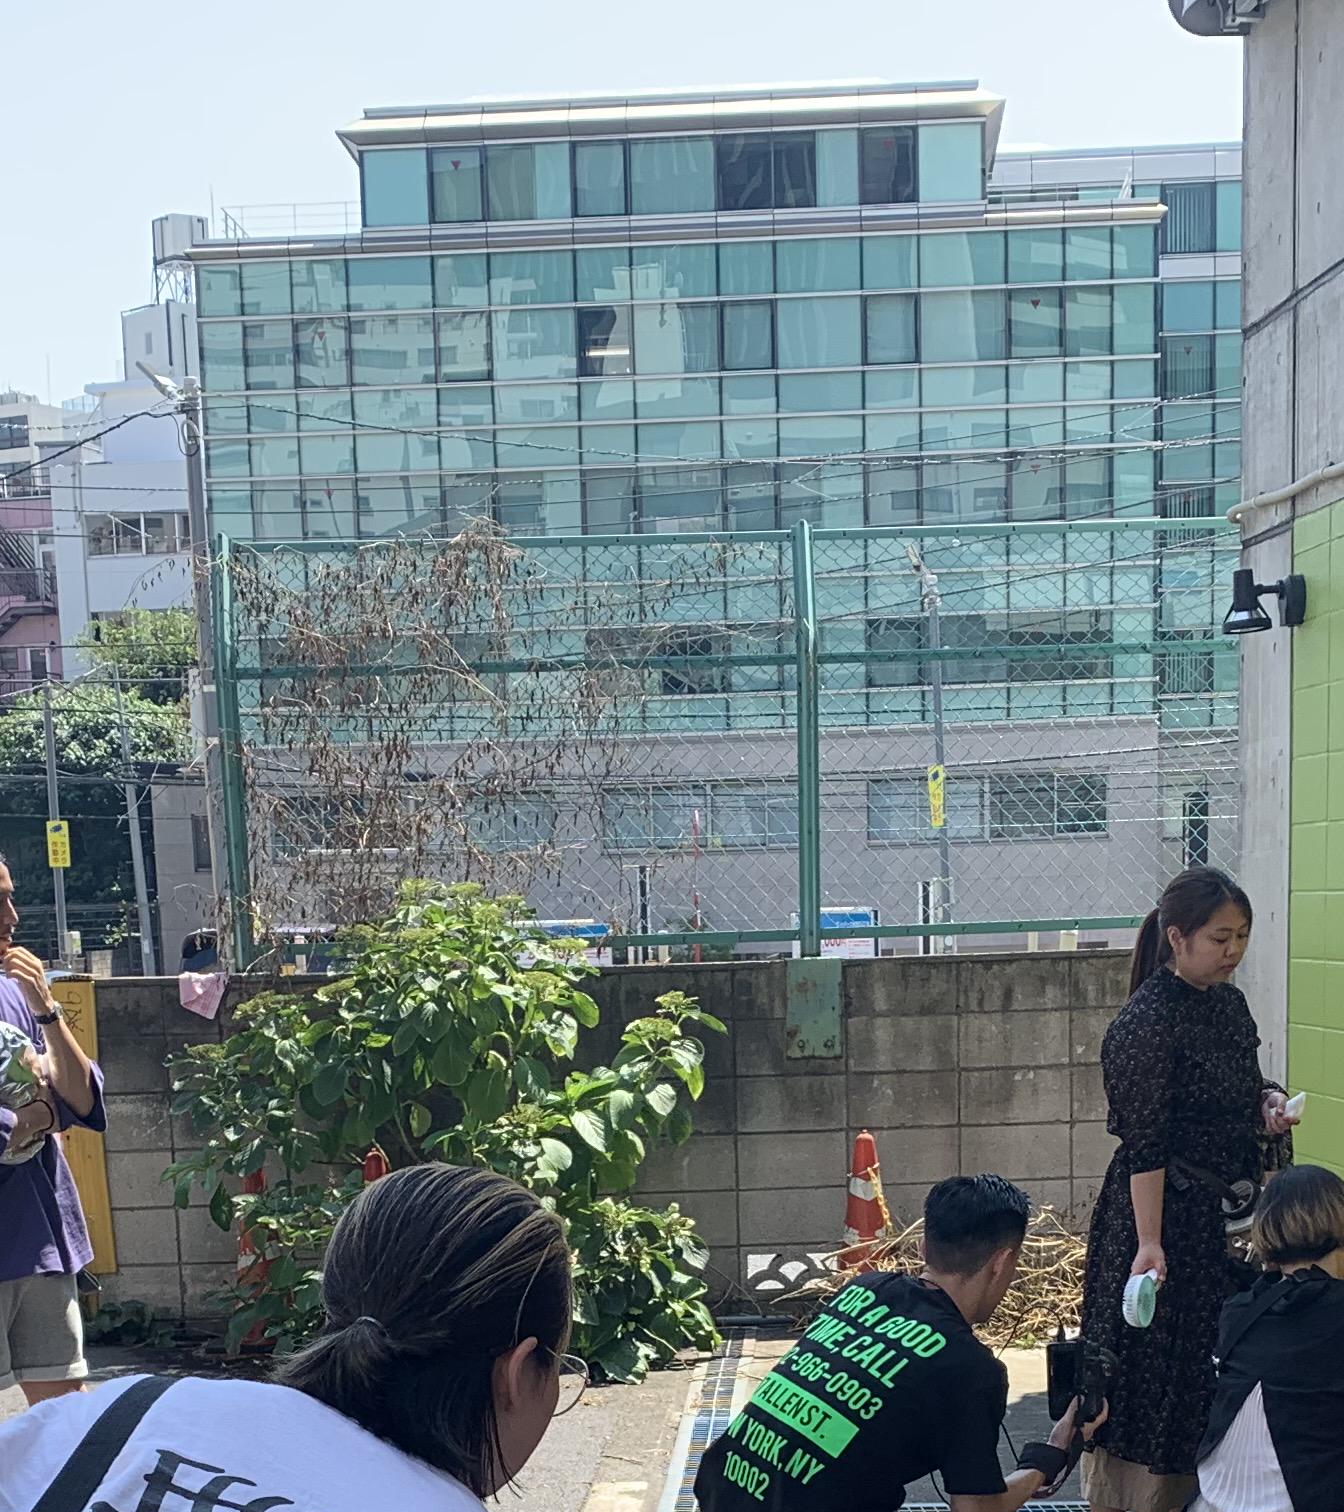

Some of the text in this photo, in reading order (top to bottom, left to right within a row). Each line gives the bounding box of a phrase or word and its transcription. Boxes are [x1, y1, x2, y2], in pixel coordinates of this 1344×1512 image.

[827, 1284, 947, 1358] FOR A GOOD
[779, 1347, 883, 1420] 2-966-0903
[842, 1335, 910, 1389] CALL
[741, 1417, 788, 1470] YORK,
[784, 1447, 825, 1485] NY
[800, 1404, 832, 1439] ST.
[723, 1451, 770, 1501] 10002
